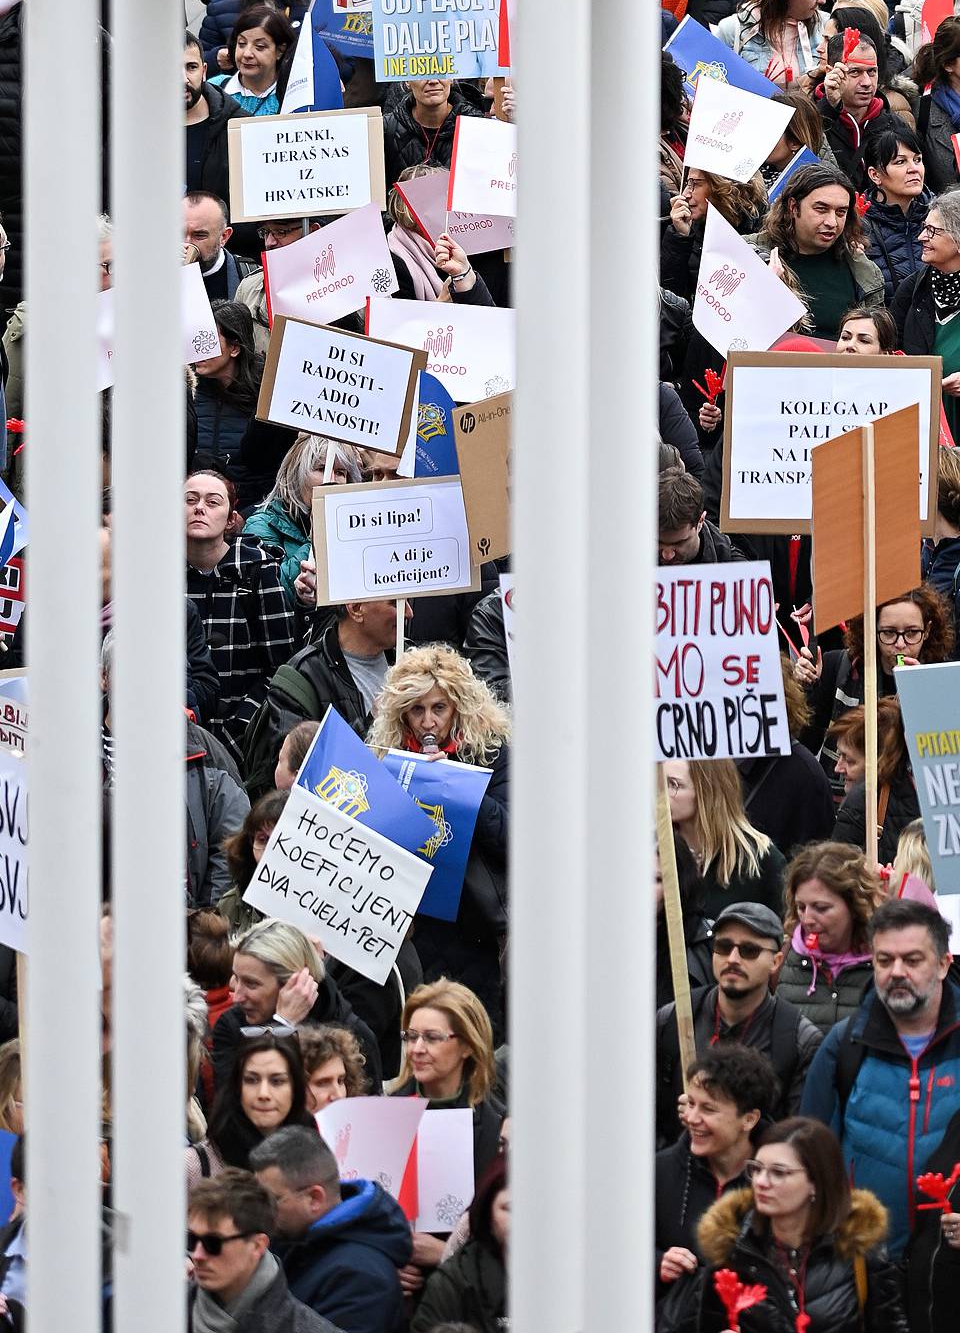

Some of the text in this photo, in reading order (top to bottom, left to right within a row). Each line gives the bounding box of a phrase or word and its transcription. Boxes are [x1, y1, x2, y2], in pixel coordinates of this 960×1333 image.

[383, 20, 450, 56] DALJE
[384, 54, 458, 76] I NE OSTAJE.
[276, 129, 334, 145] PLENKI,
[695, 134, 733, 154] PREPOROD
[262, 146, 349, 164] TJERAŠ NAS
[300, 169, 314, 180] IZ
[265, 186, 350, 203] HRVATSKE!
[448, 220, 493, 235] PREPOROD
[306, 275, 355, 303] PREPOROD
[327, 345, 365, 367] DI SI
[302, 360, 374, 392] RADOSTI
[317, 386, 361, 410] ADIO
[780, 400, 889, 416] KOLEGA AP
[290, 400, 381, 436] ZNANOSTI!
[462, 413, 475, 434] hp
[789, 424, 831, 439] PALI
[772, 448, 797, 461] NA
[349, 508, 422, 528] Di si lipa!
[389, 547, 433, 563] A di je
[374, 565, 450, 585] koeficijent?
[710, 578, 772, 637] PUNO
[722, 654, 761, 687] SE
[656, 688, 780, 758] CRNO PIŠE
[297, 808, 394, 881] HOĆEMO
[272, 832, 414, 934] KOEFICIJENT
